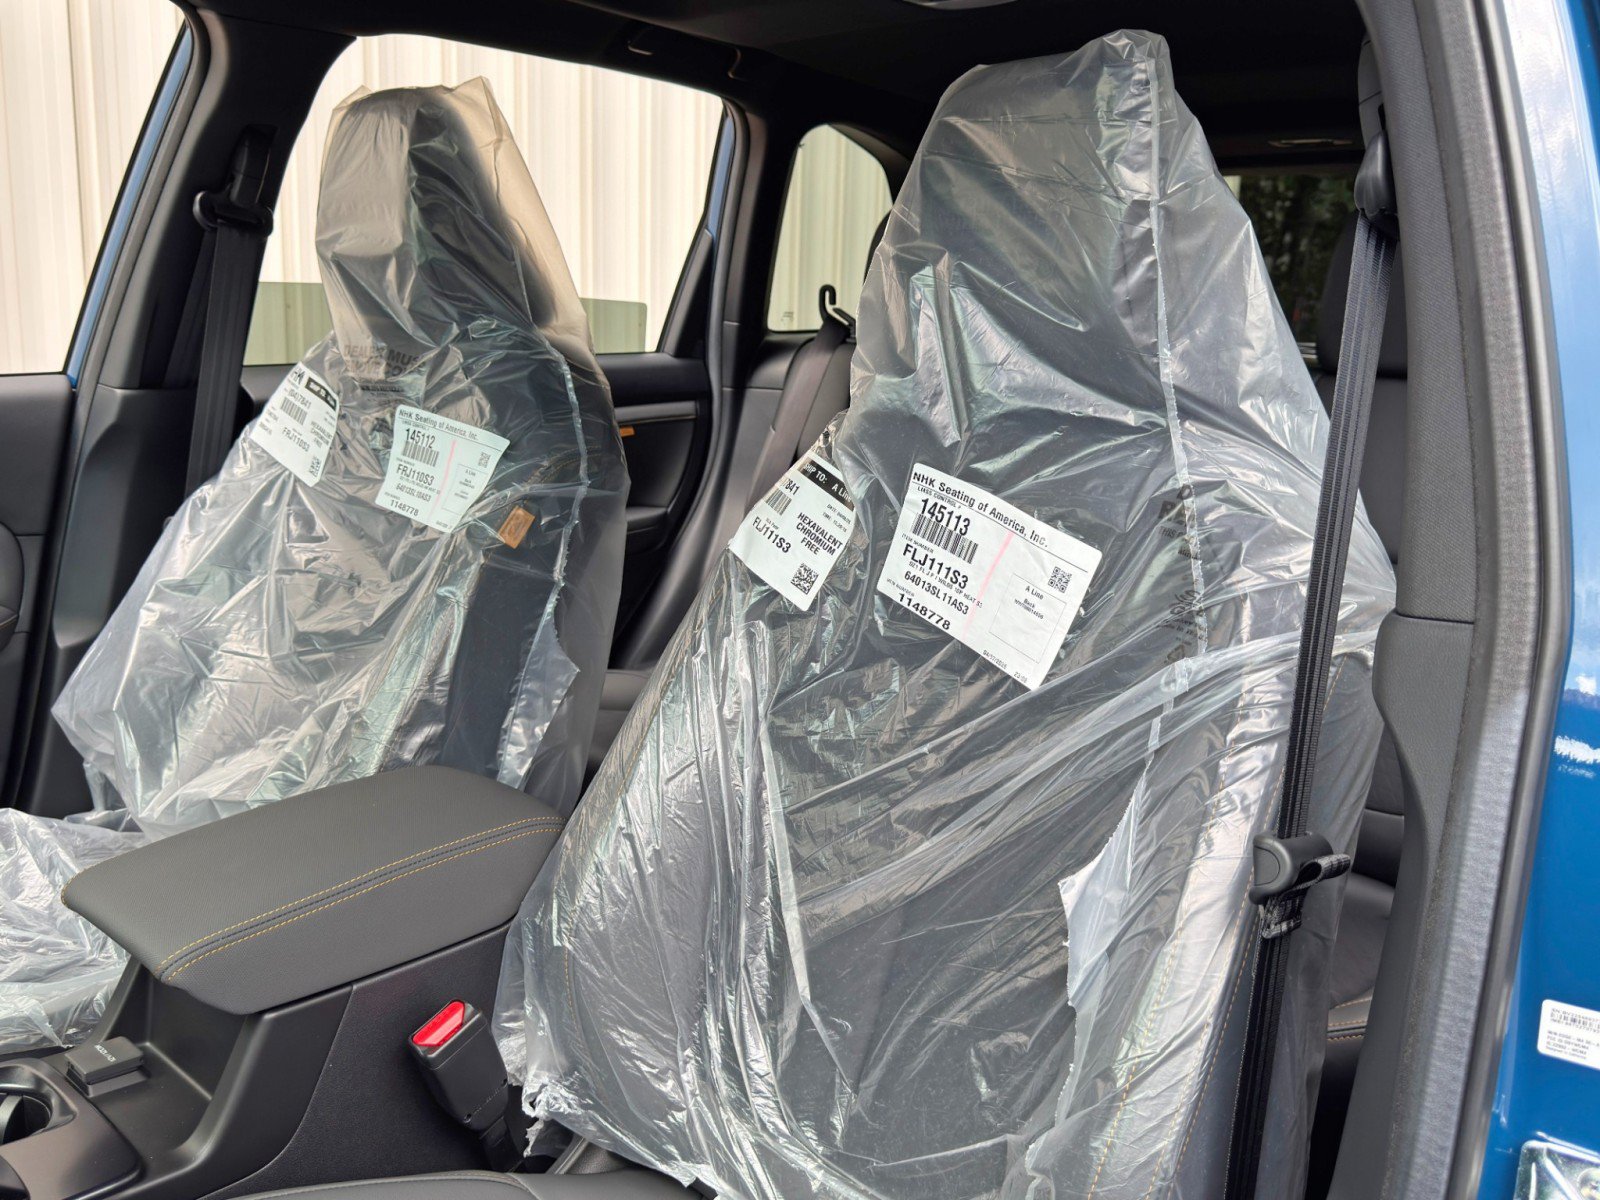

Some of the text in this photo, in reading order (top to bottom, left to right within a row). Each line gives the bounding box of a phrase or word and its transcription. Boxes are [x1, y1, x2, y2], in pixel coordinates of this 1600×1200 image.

[399, 409, 413, 419] NHK
[415, 413, 437, 428] Seating
[468, 431, 478, 440] Inc.
[406, 428, 435, 449] 145112
[397, 464, 434, 486] FRJ110S3
[803, 462, 816, 474] SHIP
[816, 471, 827, 483] TO:
[831, 483, 838, 492] A
[391, 500, 419, 516] 1148778
[913, 472, 1047, 547] NHK Seating of America, Inc.
[933, 492, 956, 507] CONTROL
[798, 513, 842, 548] HEXAVALENT
[921, 499, 970, 536] 145113
[753, 517, 791, 553] FLJ111S3
[796, 522, 838, 555] CHROMIUM
[801, 537, 820, 555] FREE
[903, 544, 968, 589] FLJ111S3
[905, 571, 969, 614] 64013SL11AS3
[1031, 588, 1044, 600] Line
[894, 594, 950, 630] 1148778
